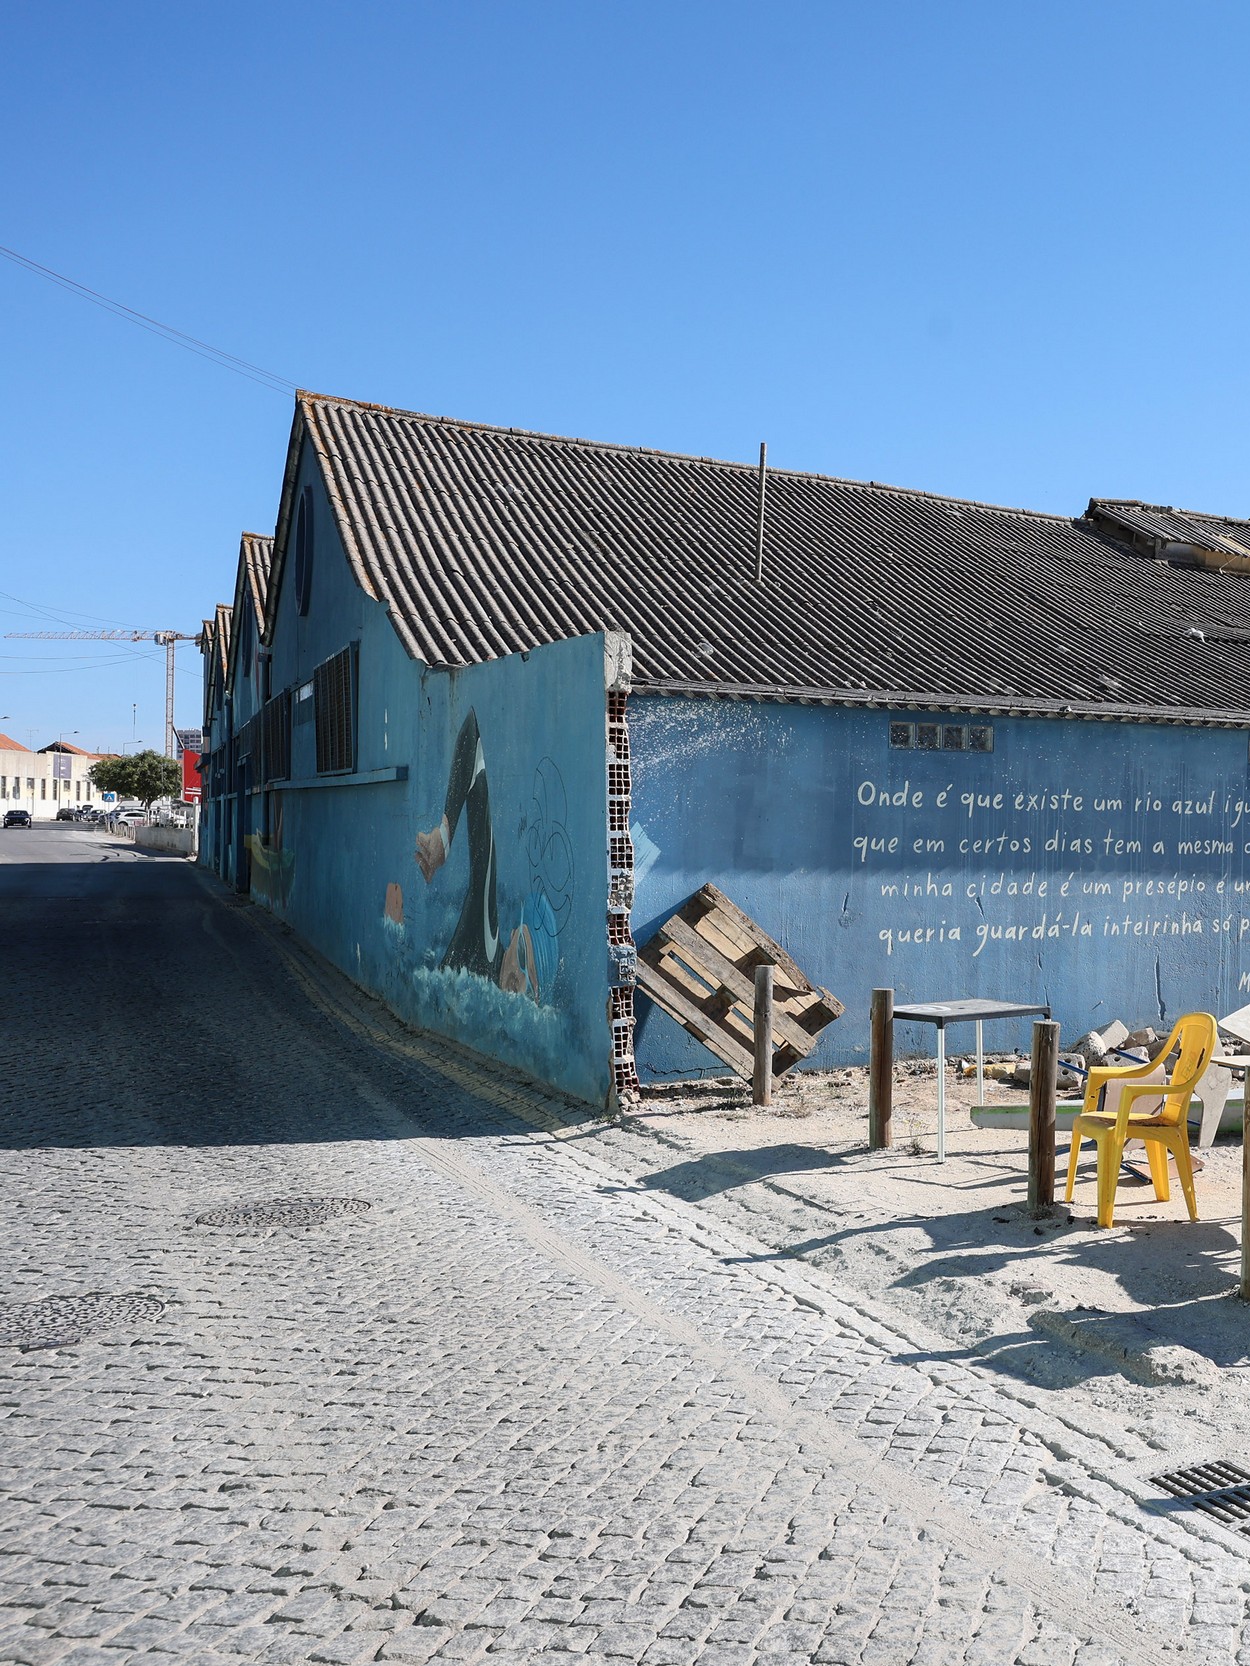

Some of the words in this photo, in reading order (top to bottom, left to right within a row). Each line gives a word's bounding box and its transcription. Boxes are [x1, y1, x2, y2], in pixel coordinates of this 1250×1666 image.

[857, 780, 923, 808] Onde
[936, 783, 953, 807] é
[961, 792, 1003, 818] que
[1014, 788, 1083, 811] existe
[1094, 797, 1122, 811] um
[1134, 792, 1161, 812] rio
[1172, 791, 1216, 815] azul
[853, 835, 898, 862] que
[913, 838, 945, 853] em
[959, 830, 1031, 855] certos
[1044, 829, 1093, 854] dias
[1103, 829, 1141, 856] tem
[1152, 842, 1165, 855] a
[1178, 840, 1234, 855] mesma
[881, 873, 952, 897] minha
[966, 872, 1048, 898] cidade
[1060, 872, 1075, 896] é
[1083, 881, 1112, 895] um
[1122, 873, 1205, 903] presépio
[1216, 873, 1228, 894] é
[879, 920, 961, 956] queria
[972, 912, 1092, 957] guardá-la
[1103, 912, 1202, 936] inteirinha
[1212, 914, 1231, 931] só
